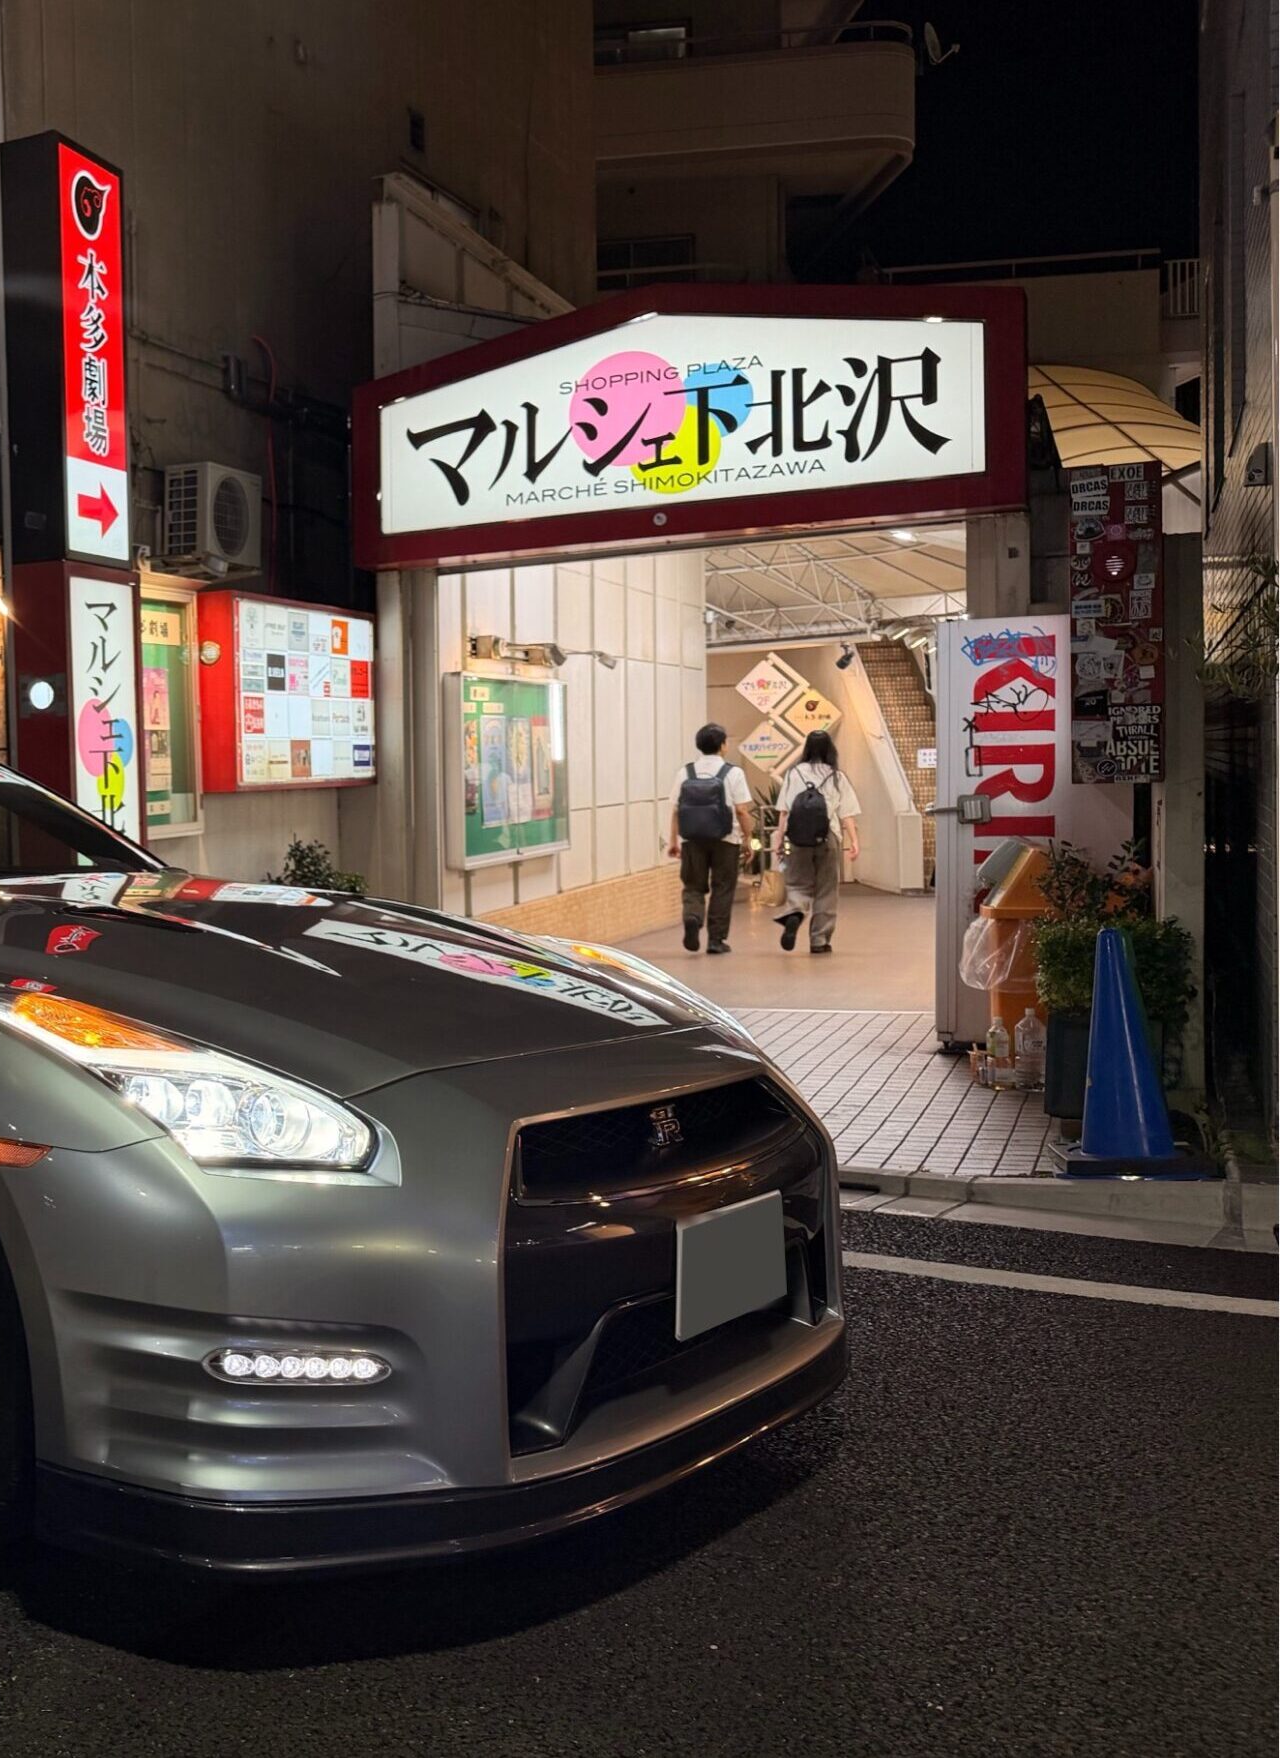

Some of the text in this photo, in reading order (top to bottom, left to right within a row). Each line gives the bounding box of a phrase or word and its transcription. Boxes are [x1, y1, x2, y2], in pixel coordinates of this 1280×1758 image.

[77, 249, 109, 456] 本多劇場
[406, 346, 954, 507] マルシェ下北沢
[559, 355, 764, 396] SHOPPING PLAZA
[505, 458, 827, 507] MARCHÉ SHIMOKITAZAWA
[84, 601, 127, 835] マルシェ下北
[973, 634, 1056, 866] KIRI
